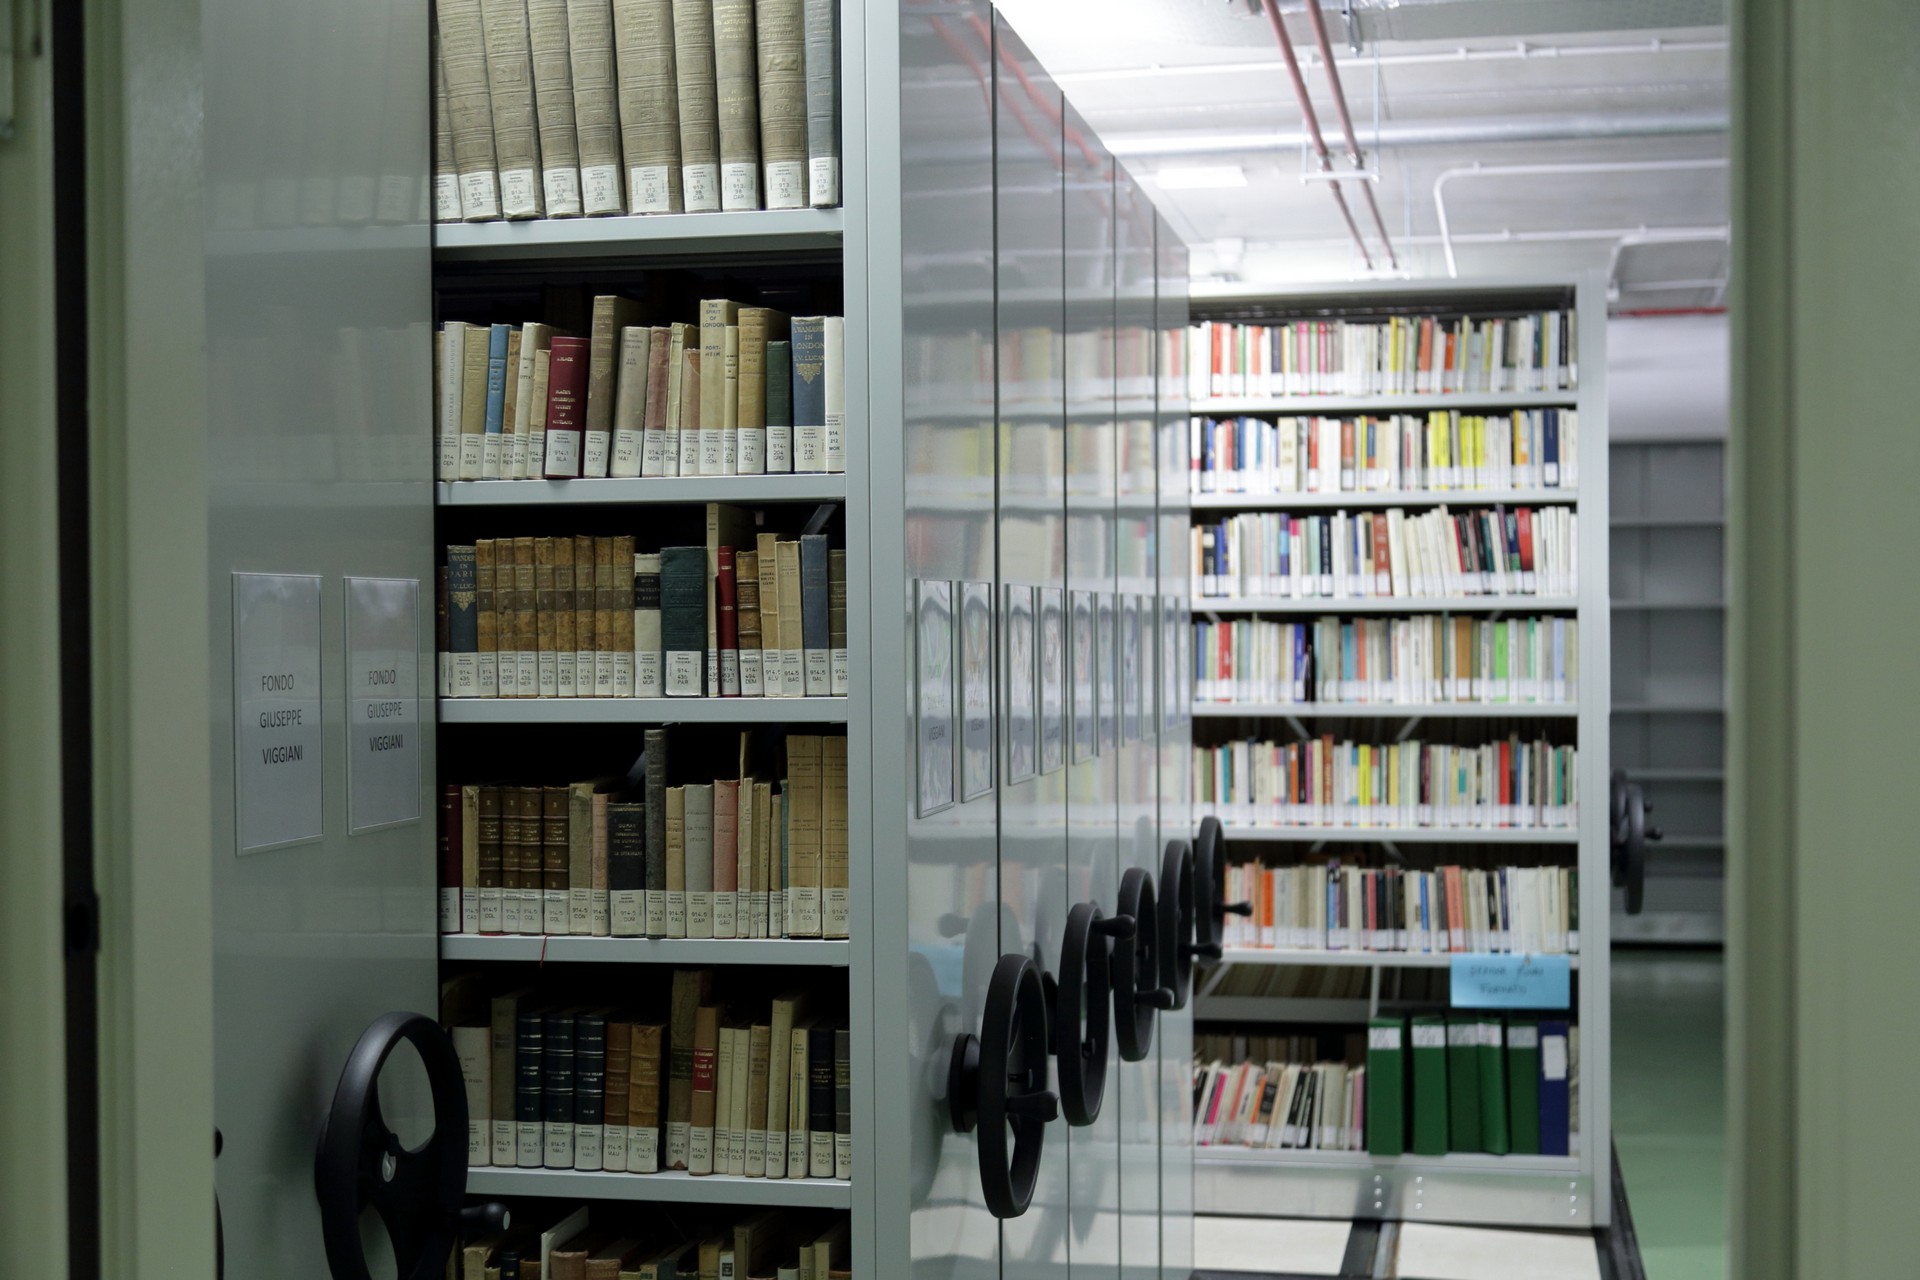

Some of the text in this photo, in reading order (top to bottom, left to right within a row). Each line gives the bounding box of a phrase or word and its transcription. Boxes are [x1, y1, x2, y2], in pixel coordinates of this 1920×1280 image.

[262, 674, 294, 692] FONDO
[369, 669, 396, 686] FONDO
[260, 709, 302, 728] GIUSEPPE
[367, 701, 402, 719] GIUSEPPE
[369, 734, 403, 752] VIGGIANI
[262, 745, 303, 765] VIGGIANI
